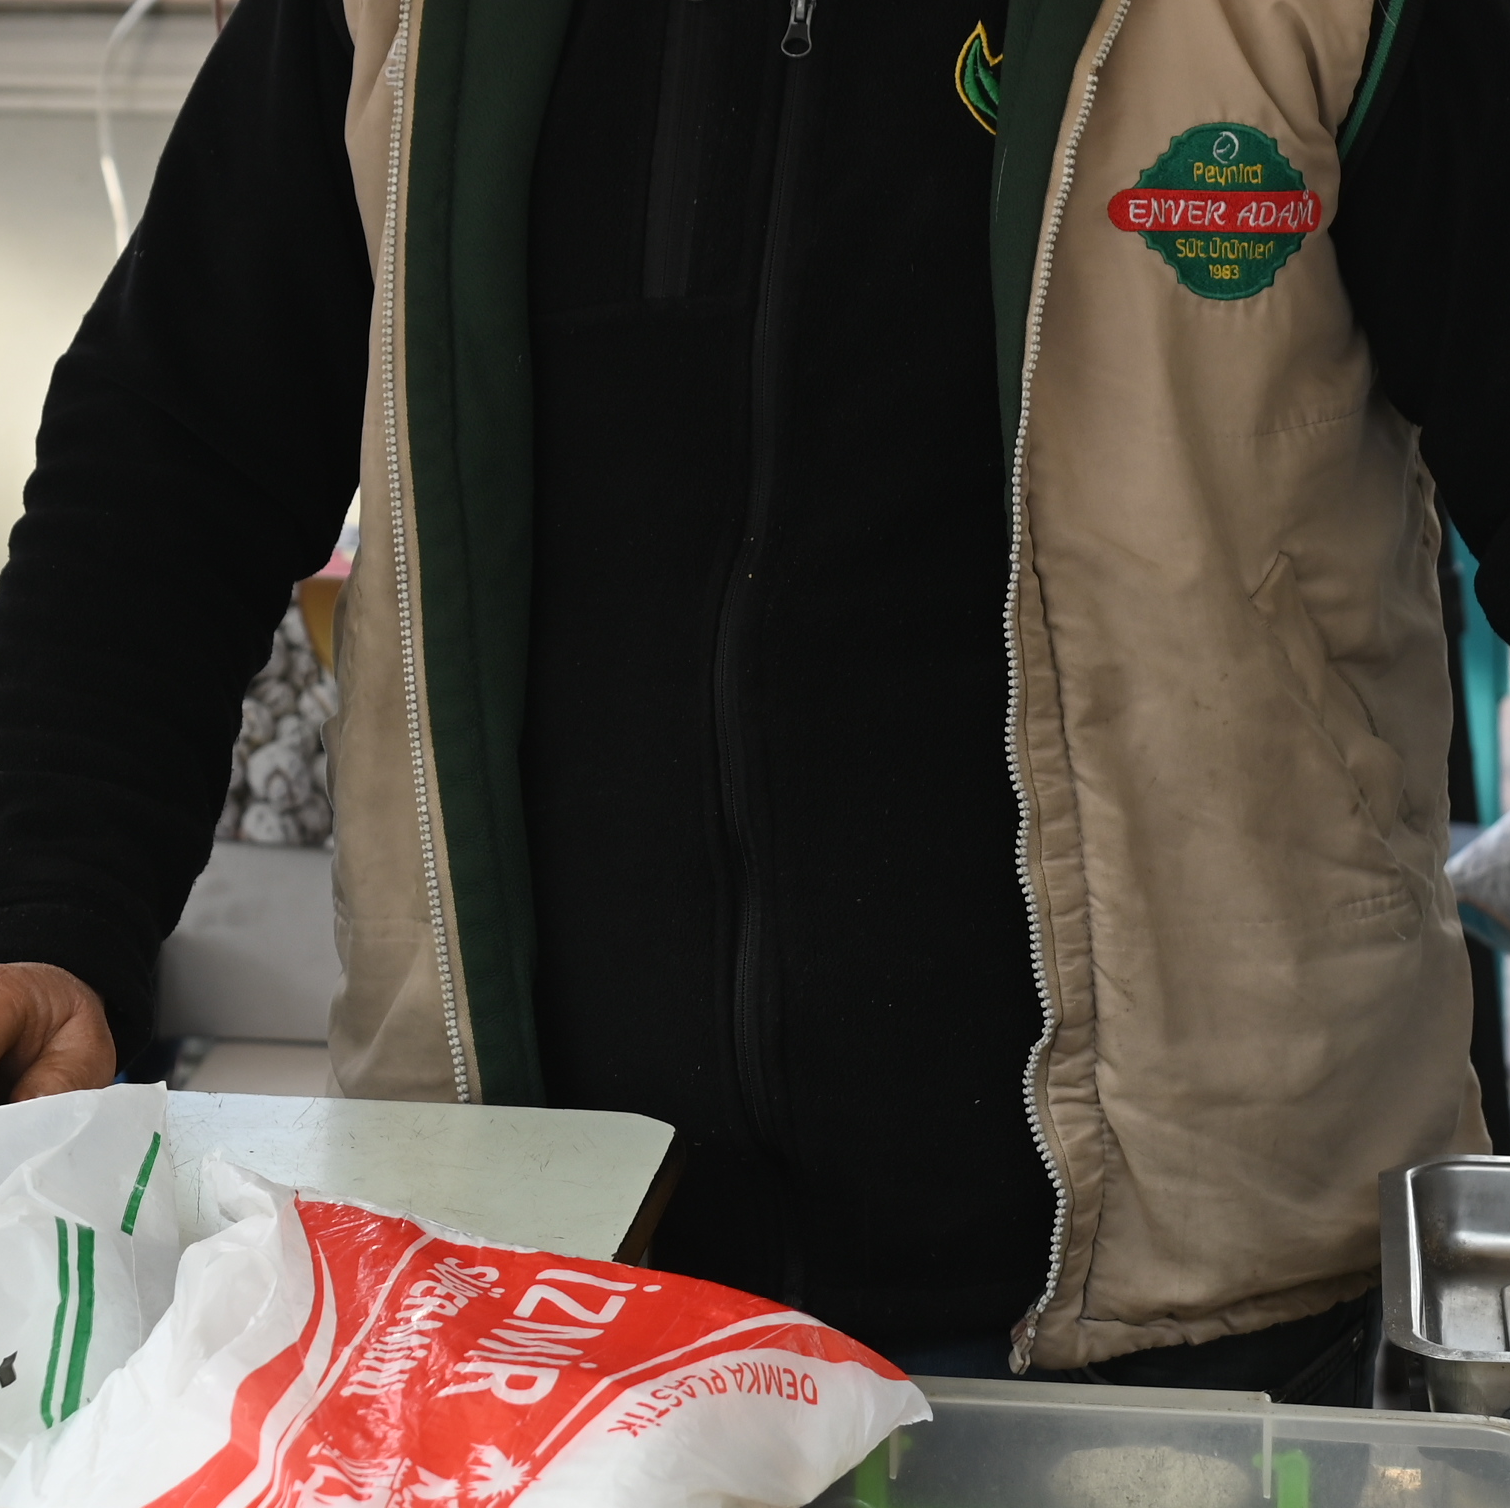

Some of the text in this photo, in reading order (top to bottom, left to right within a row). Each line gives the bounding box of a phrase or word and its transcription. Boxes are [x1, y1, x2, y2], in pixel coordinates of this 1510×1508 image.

[1128, 198, 1315, 229] ENVER ADAM
[1208, 264, 1241, 280] 1983
[722, 1361, 820, 1406] DEMKA
